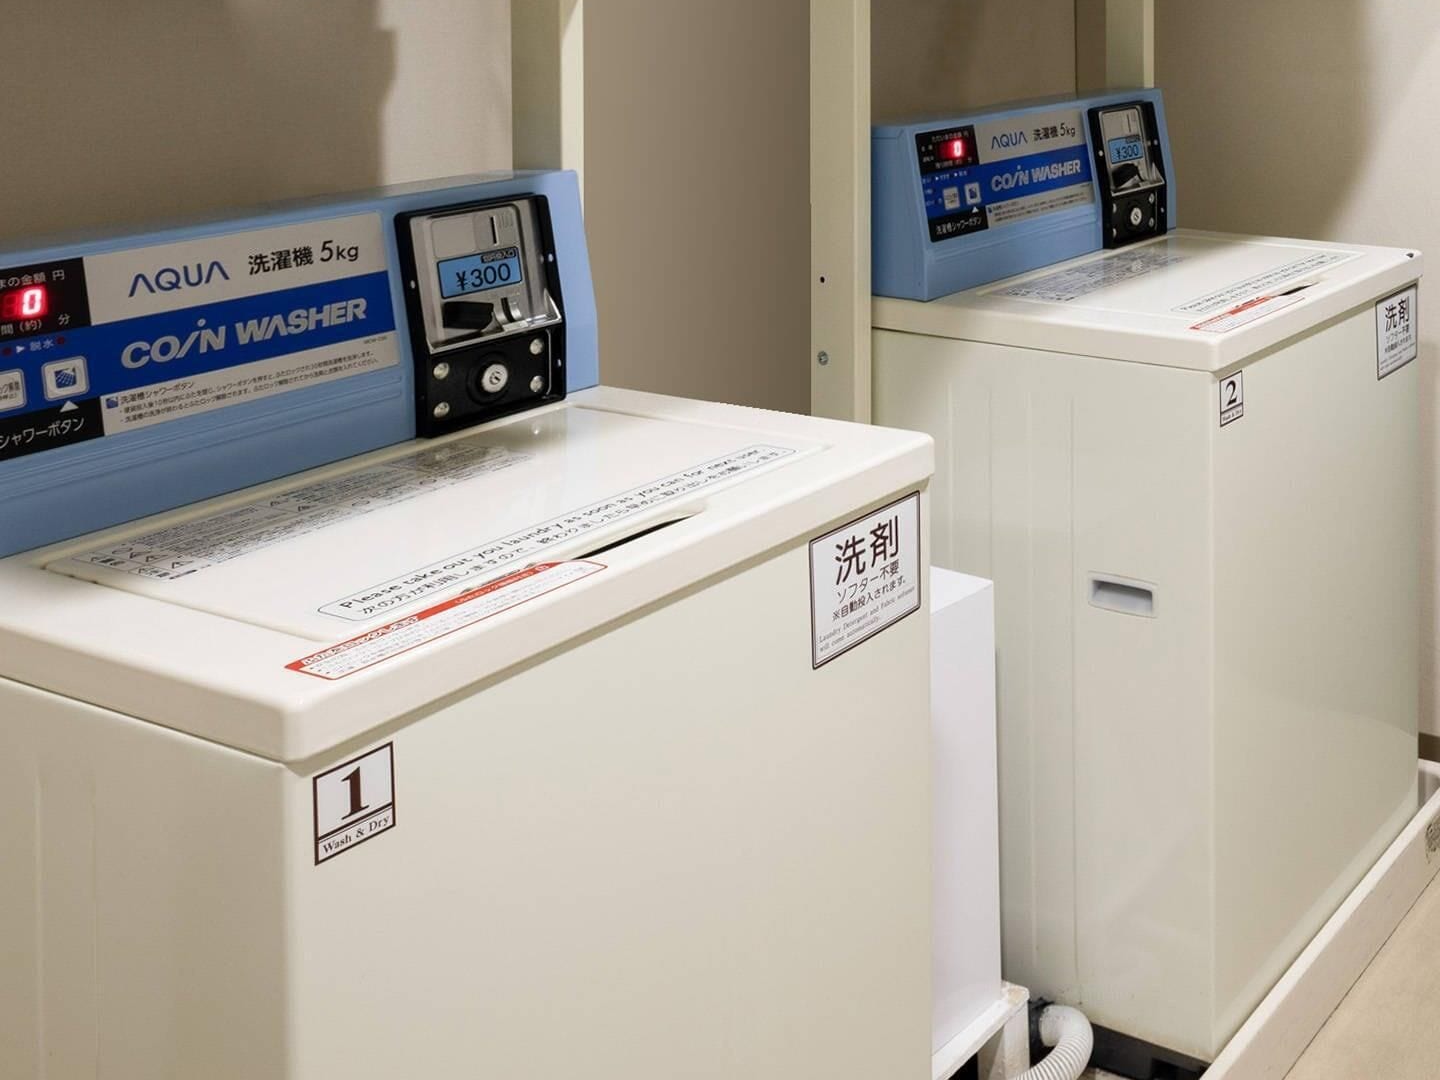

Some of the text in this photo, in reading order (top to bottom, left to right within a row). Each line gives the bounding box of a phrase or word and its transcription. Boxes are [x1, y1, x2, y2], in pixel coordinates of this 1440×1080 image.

[953, 140, 963, 157] 0
[991, 131, 1028, 150] AQUA
[1059, 122, 1076, 138] 5kg
[1115, 144, 1139, 160] ¥300
[1031, 159, 1081, 183] WASHER
[52, 269, 65, 281] 円
[128, 240, 359, 298] AQUA 洗濯機 5kg
[456, 262, 511, 291] ¥300
[22, 288, 42, 316] 0
[1384, 295, 1410, 332] 洗剤
[58, 313, 70, 325] 分
[235, 297, 367, 346] WASHER
[29, 338, 55, 352] 脱水
[1226, 380, 1237, 407] 2
[339, 583, 400, 609] Please
[402, 568, 443, 586] take
[443, 556, 473, 571] out
[473, 544, 504, 560] you
[501, 521, 562, 547] laundry
[582, 502, 616, 517] soon
[616, 496, 633, 504] as
[636, 485, 660, 499] you
[660, 477, 681, 488] can
[681, 469, 703, 480] for
[707, 459, 736, 470] next
[834, 515, 899, 585] 洗剤
[837, 559, 900, 604] ソフター不要
[341, 766, 369, 820] 1
[322, 816, 390, 854] Wash & Dry
